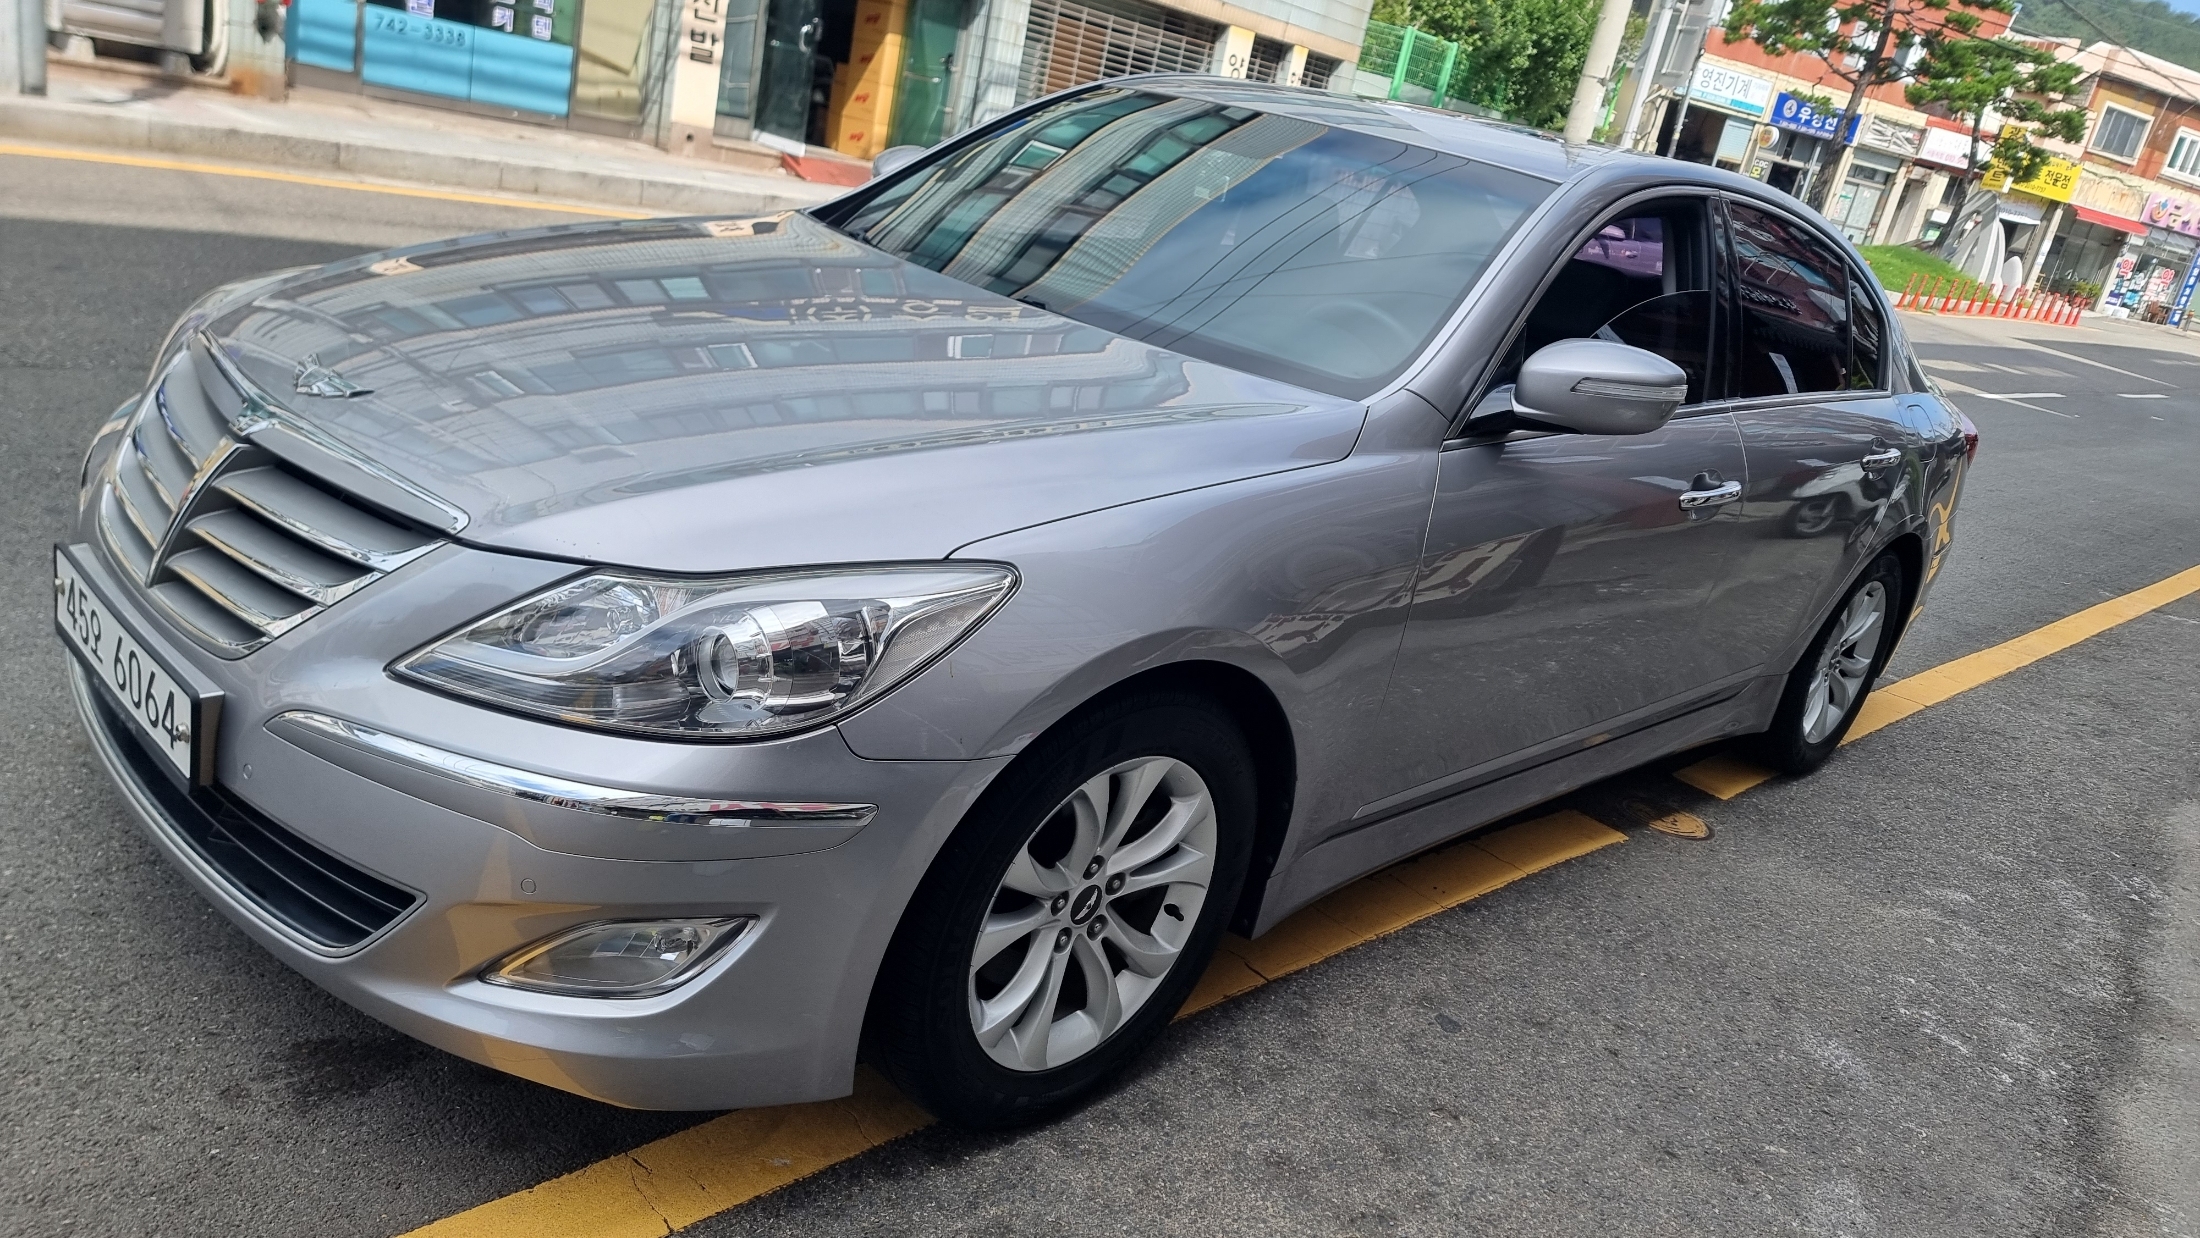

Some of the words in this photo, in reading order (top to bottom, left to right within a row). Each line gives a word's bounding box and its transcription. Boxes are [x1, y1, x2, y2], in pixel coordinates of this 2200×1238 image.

[1700, 68, 1752, 99] 영진기계
[2043, 169, 2072, 190] 전문점
[66, 576, 104, 664] 45오
[113, 634, 178, 750] 6064
